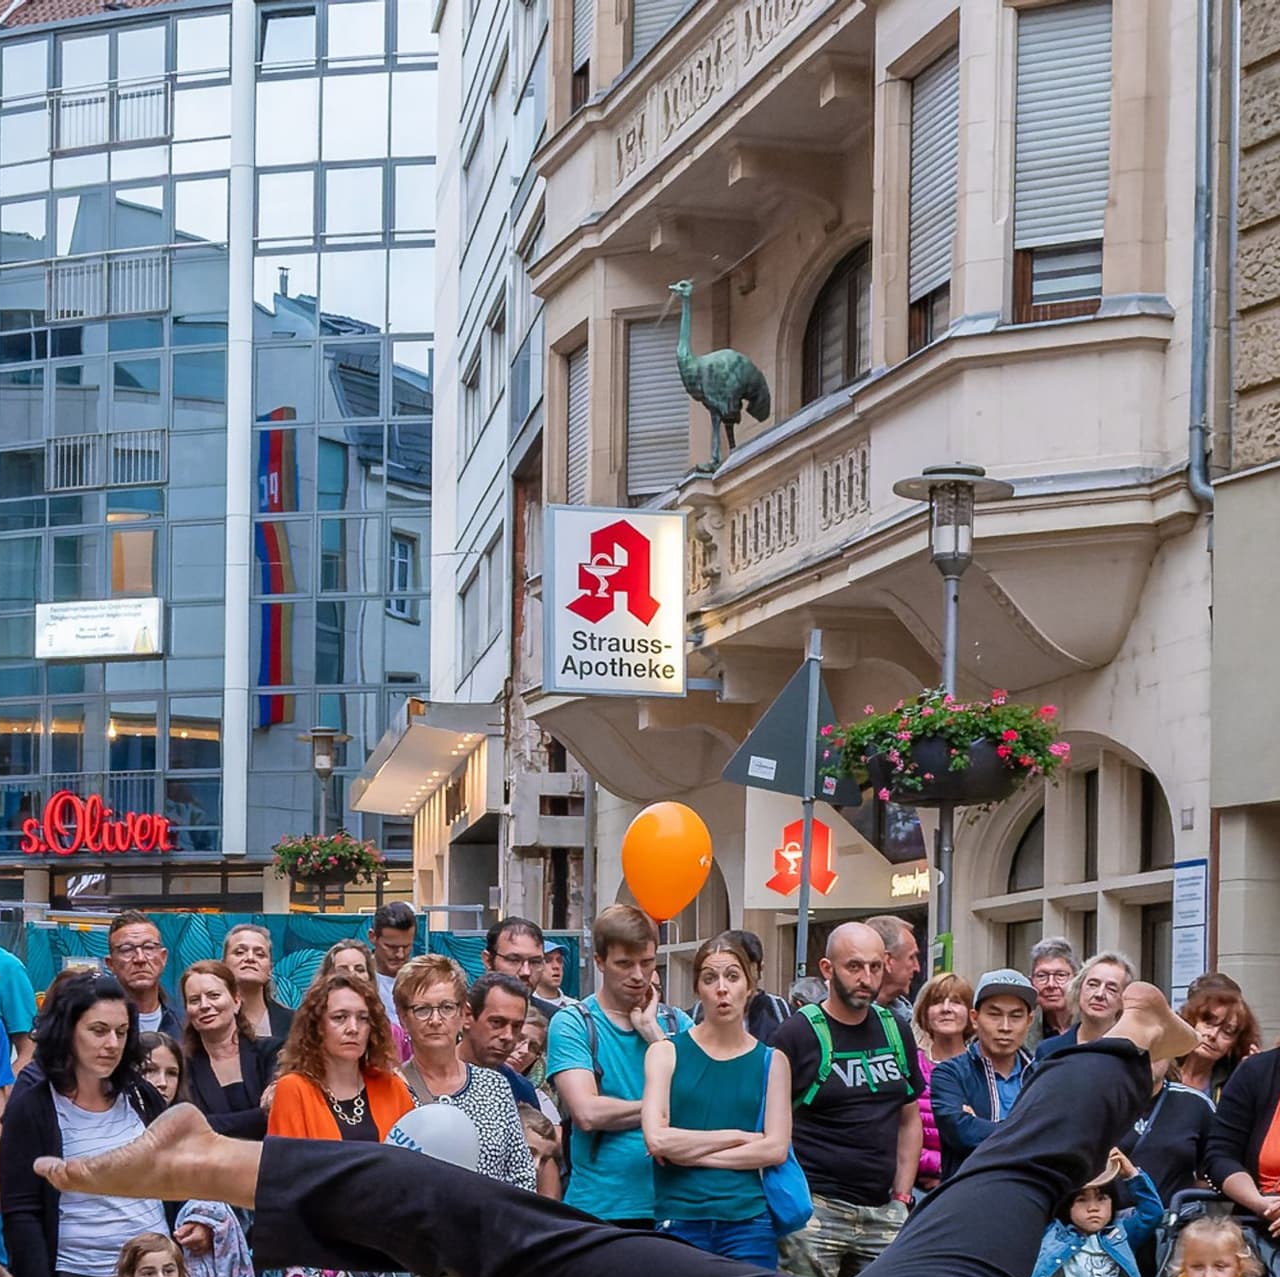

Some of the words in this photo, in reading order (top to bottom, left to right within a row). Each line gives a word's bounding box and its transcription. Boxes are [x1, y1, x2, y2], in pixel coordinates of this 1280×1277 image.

[572, 631, 673, 654] Strauss-
[561, 655, 675, 680] Apotheke
[21, 789, 171, 855] s.Oliver
[831, 1054, 901, 1087] VANS
